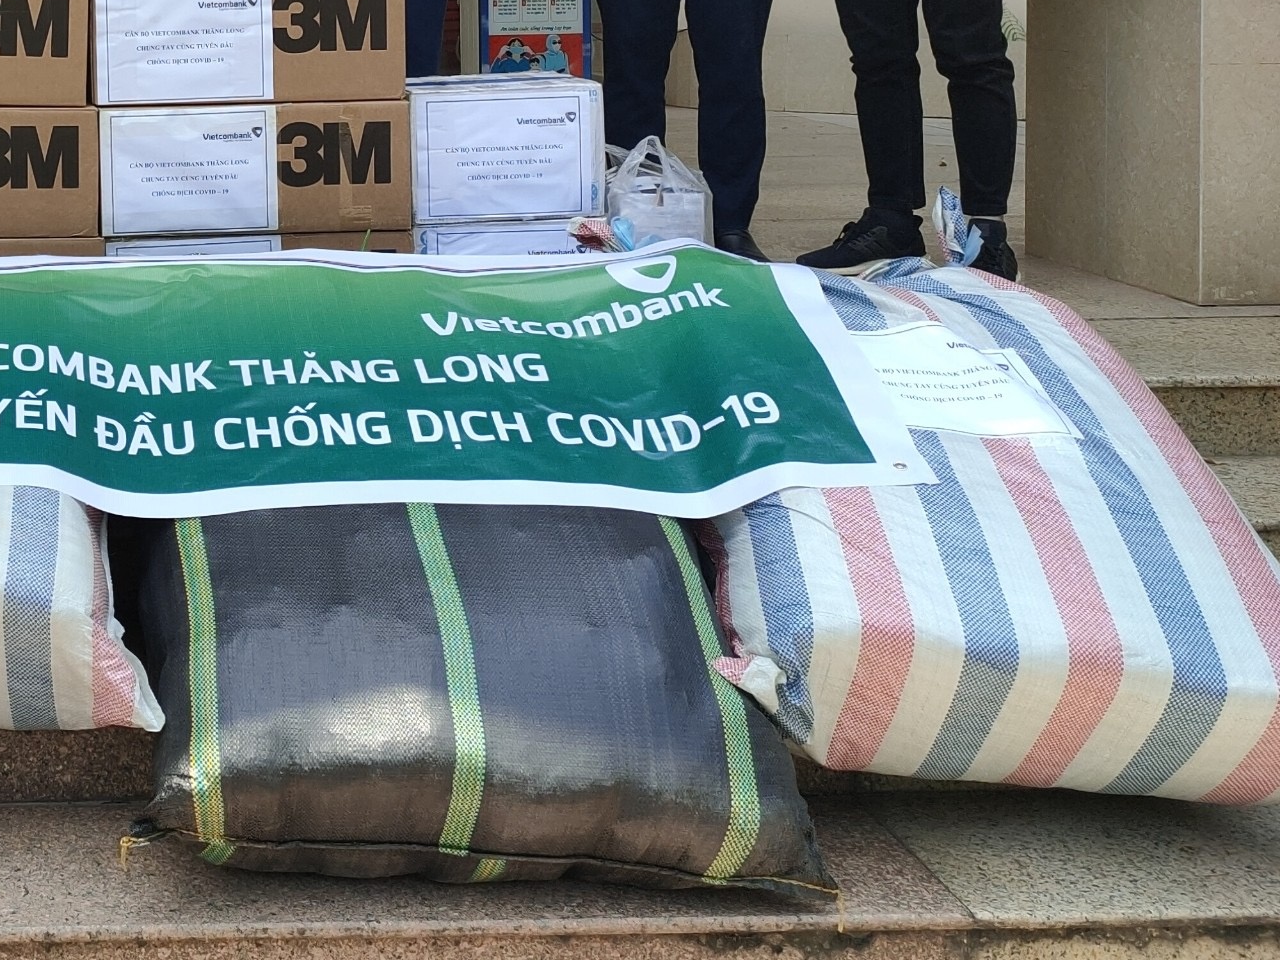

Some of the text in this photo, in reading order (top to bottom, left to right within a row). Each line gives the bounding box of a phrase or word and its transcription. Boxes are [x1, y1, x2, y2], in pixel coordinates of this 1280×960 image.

[198, 0, 247, 9] Vietcombank
[517, 117, 565, 125] Vietcombank
[202, 132, 252, 141] Vietcombank
[155, 160, 205, 168] VIETCOMBANK
[277, 121, 391, 187] 3M
[421, 283, 730, 339] Vietcombank
[229, 350, 400, 387] THĂNG
[415, 354, 549, 384] LONG
[95, 411, 195, 457] ĐẦU
[214, 404, 392, 450] CHỐNG
[407, 409, 532, 452] DỊCH
